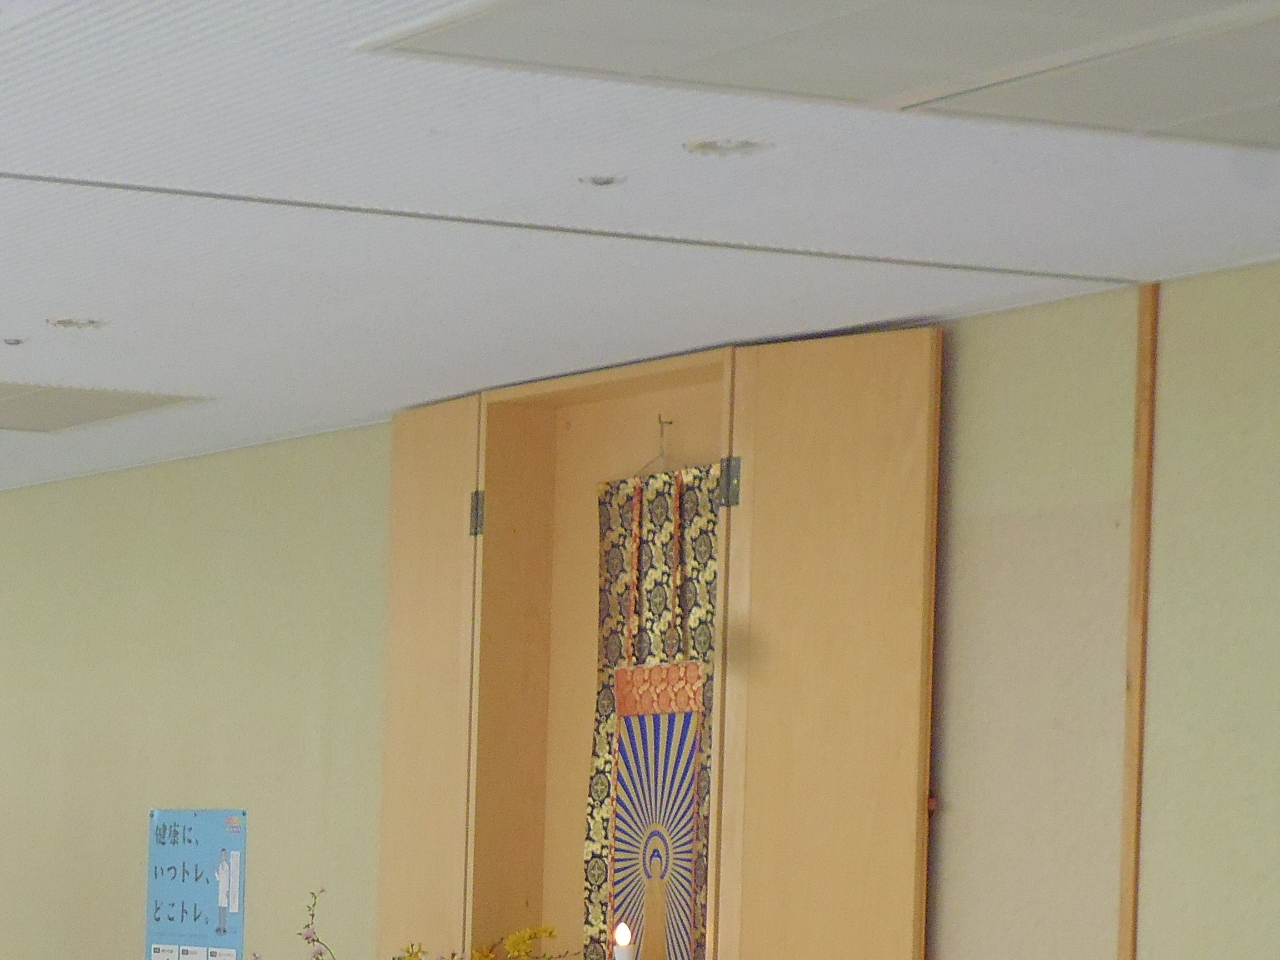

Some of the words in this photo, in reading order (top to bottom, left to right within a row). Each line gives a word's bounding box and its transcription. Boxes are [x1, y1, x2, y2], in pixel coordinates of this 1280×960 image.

[155, 822, 199, 846] 健康に、
[154, 861, 210, 885] いつトレ、
[153, 899, 209, 925] どこトレ。
